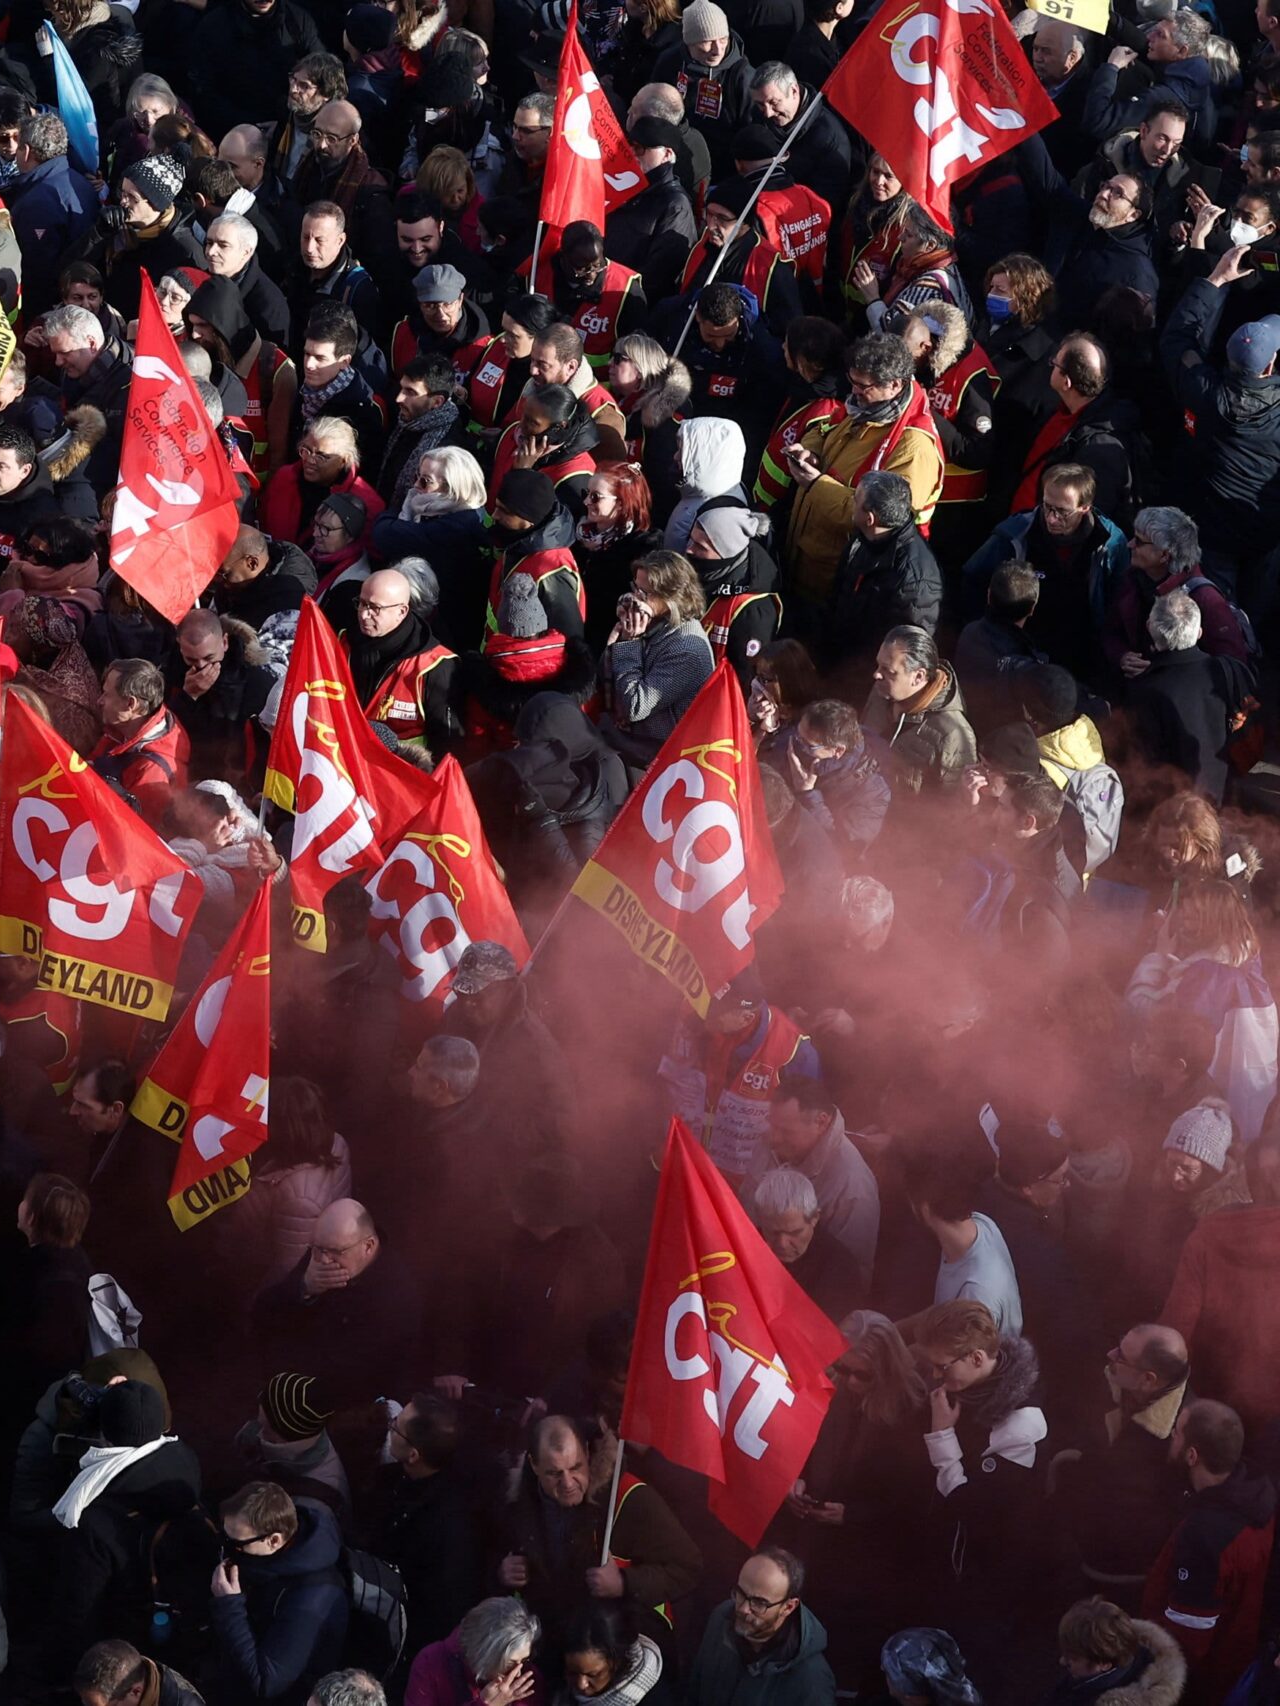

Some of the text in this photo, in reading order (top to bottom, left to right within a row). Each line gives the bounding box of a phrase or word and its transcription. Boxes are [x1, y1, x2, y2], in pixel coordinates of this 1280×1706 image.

[580, 313, 609, 333] cgt
[712, 381, 736, 397] cgt
[128, 407, 167, 465] Services
[143, 399, 194, 476] Commerce
[743, 1071, 770, 1090] cgt
